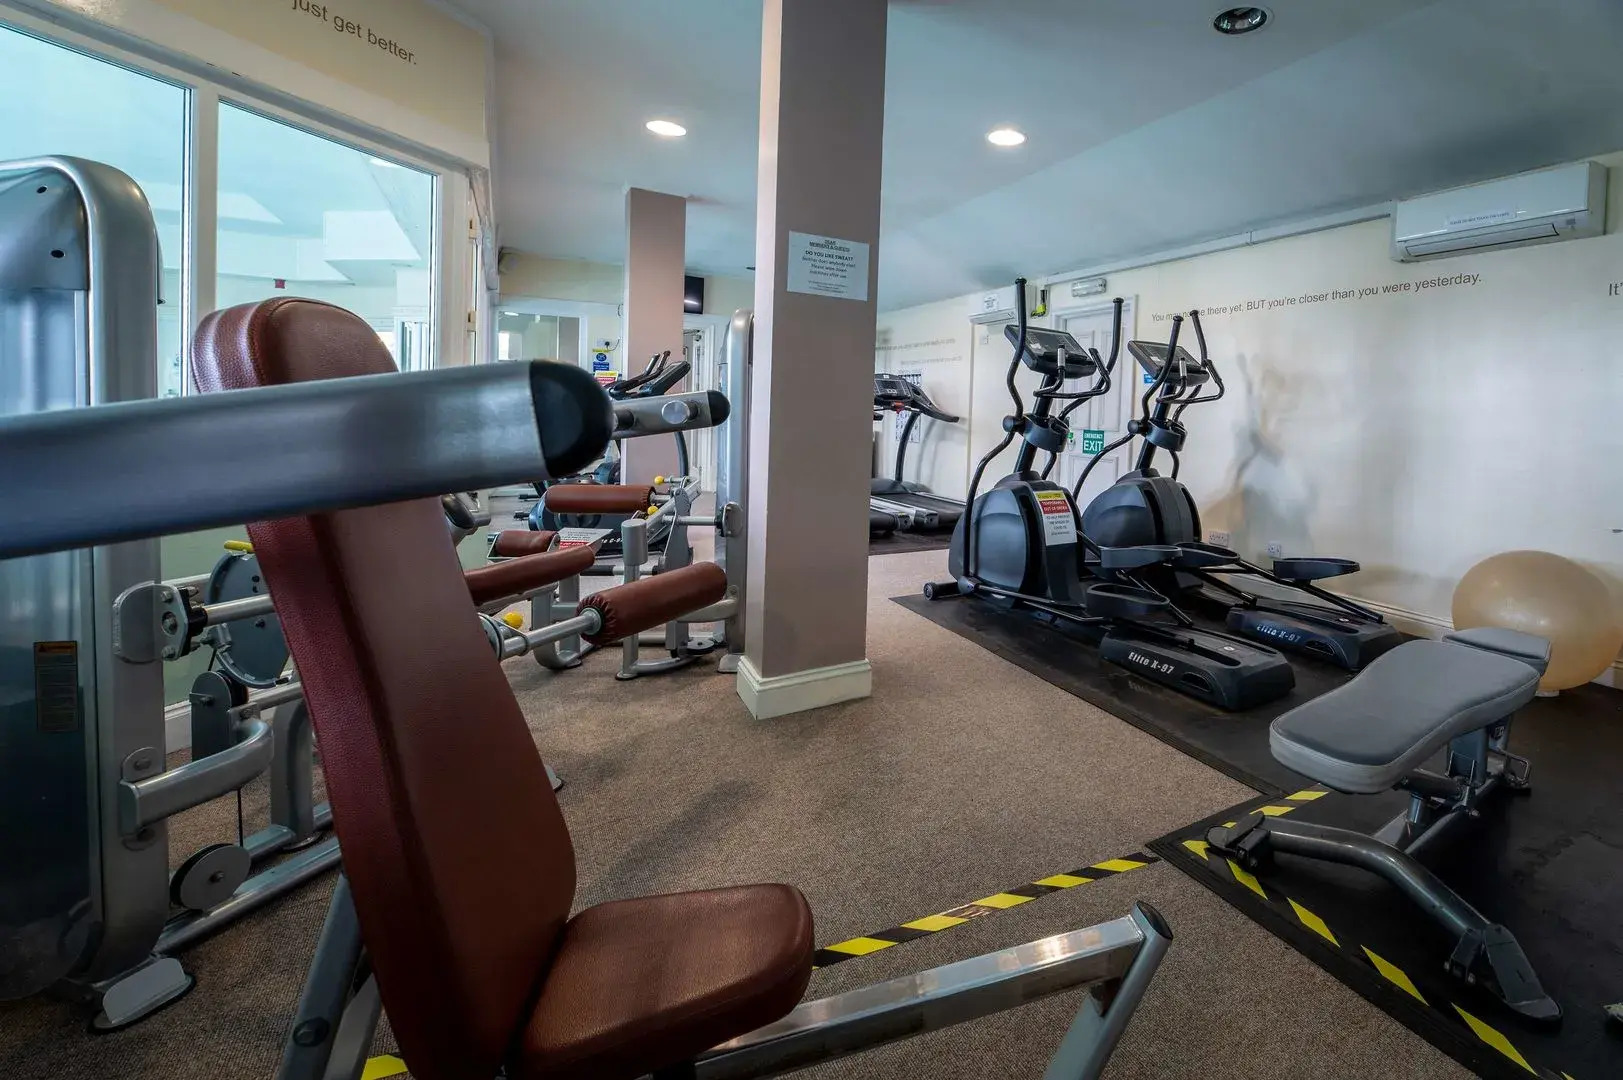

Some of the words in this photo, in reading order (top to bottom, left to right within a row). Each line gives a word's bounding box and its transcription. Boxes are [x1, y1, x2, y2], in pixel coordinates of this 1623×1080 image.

[292, 0, 328, 21] just
[333, 15, 362, 38] get
[367, 28, 417, 65] better.
[835, 254, 854, 262] SWEAT?
[1151, 313, 1164, 322] You
[1207, 306, 1227, 315] there
[1229, 303, 1244, 314] yet,
[1246, 299, 1267, 311] BUT
[1268, 296, 1296, 310] you're
[1299, 293, 1329, 304] closer
[1332, 289, 1355, 300] than
[1358, 286, 1379, 299] you
[1382, 282, 1411, 293] were
[1415, 272, 1482, 293] yesterday.
[1084, 440, 1103, 452] EXIT
[1256, 624, 1277, 636] Elite
[1128, 651, 1150, 666] Elite
[1150, 659, 1175, 675] X-97
